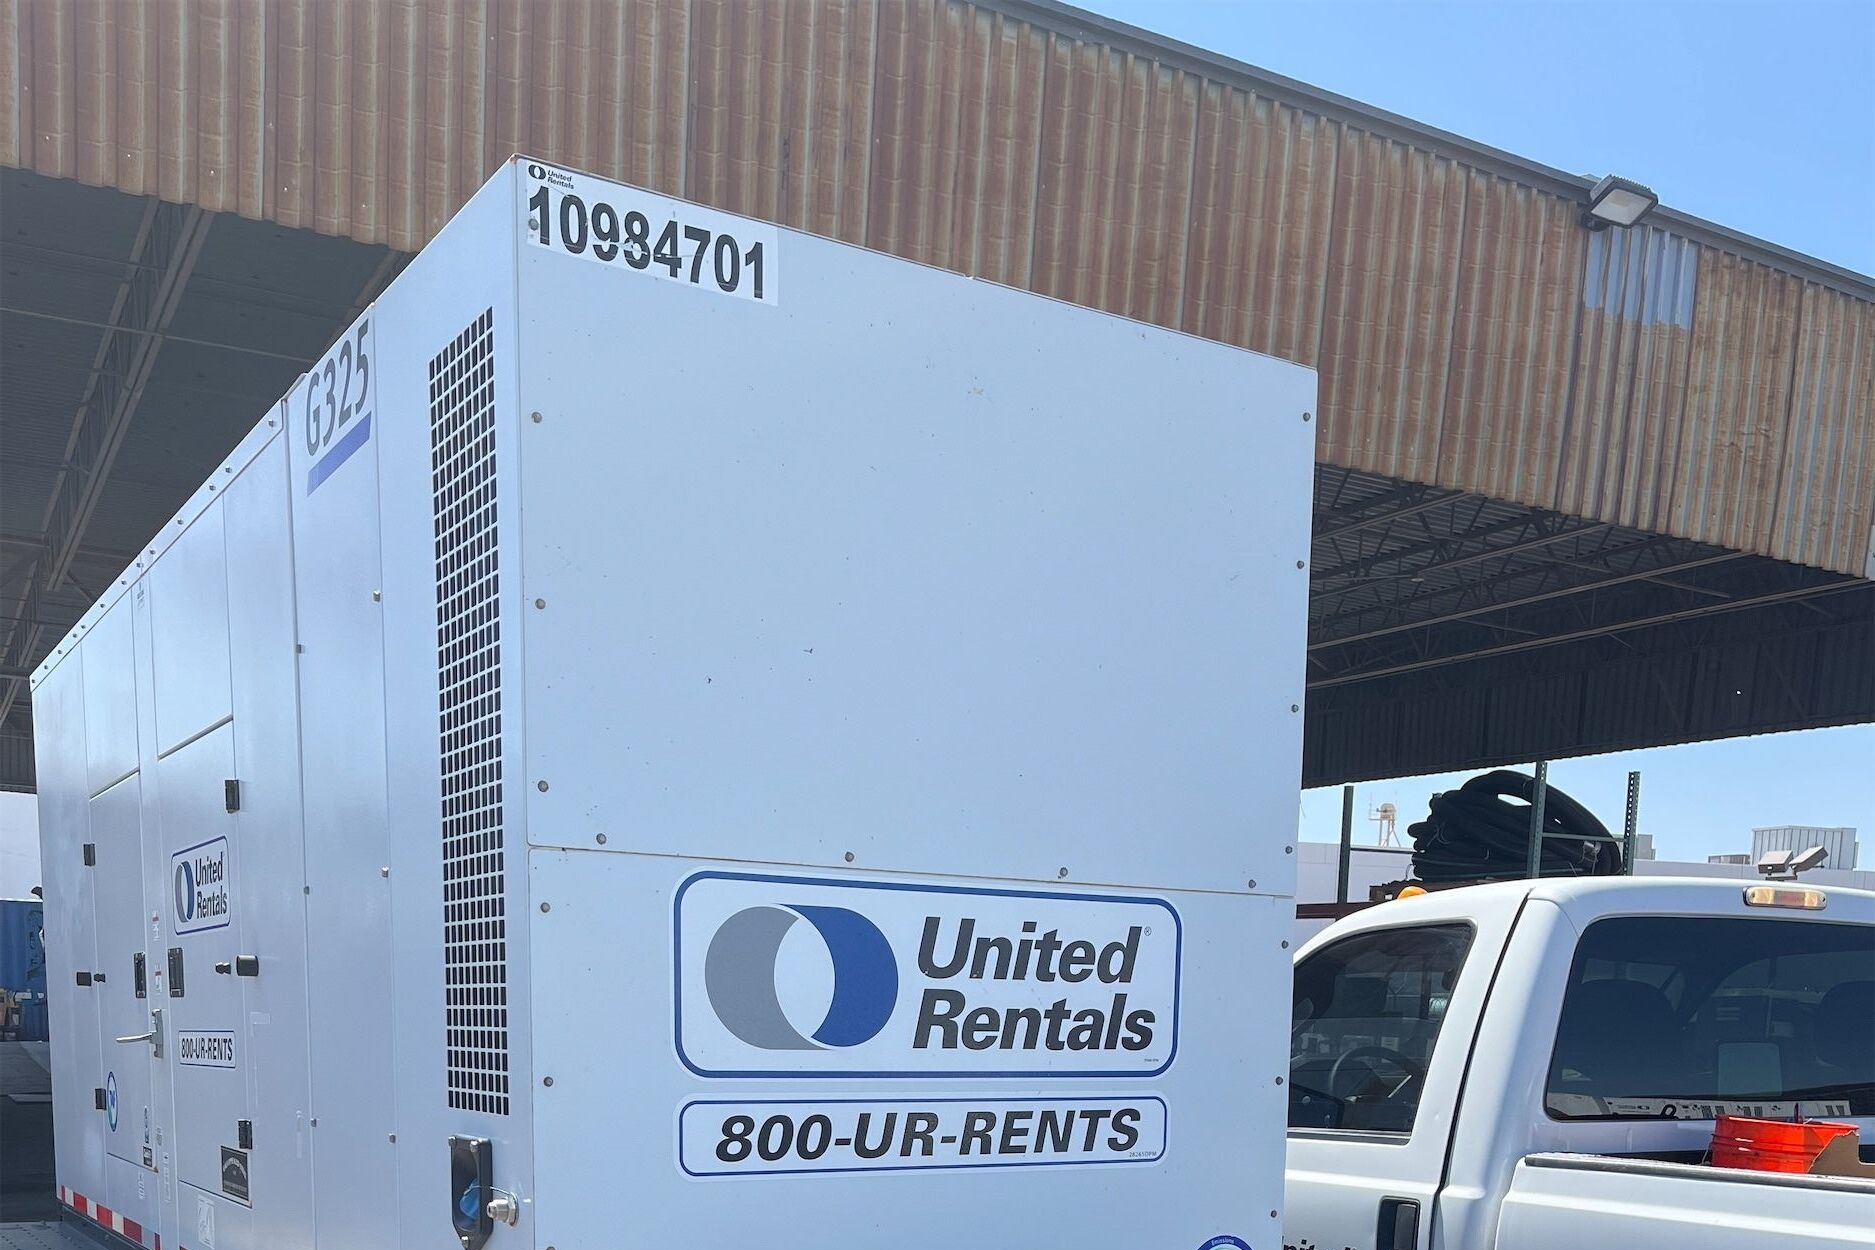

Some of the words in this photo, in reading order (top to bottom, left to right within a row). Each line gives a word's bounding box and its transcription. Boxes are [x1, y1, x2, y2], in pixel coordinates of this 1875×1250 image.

[547, 169, 573, 182] United
[547, 177, 575, 190] Rentals
[529, 186, 763, 299] 10984701
[306, 318, 369, 457] G325
[195, 851, 224, 887] United
[196, 885, 228, 919] Rentals
[917, 916, 1142, 984] United
[912, 988, 1156, 1051] Rentals
[181, 1037, 233, 1061] 800-UR-RENTS
[715, 1108, 1142, 1163] 800-UR-RENTS
